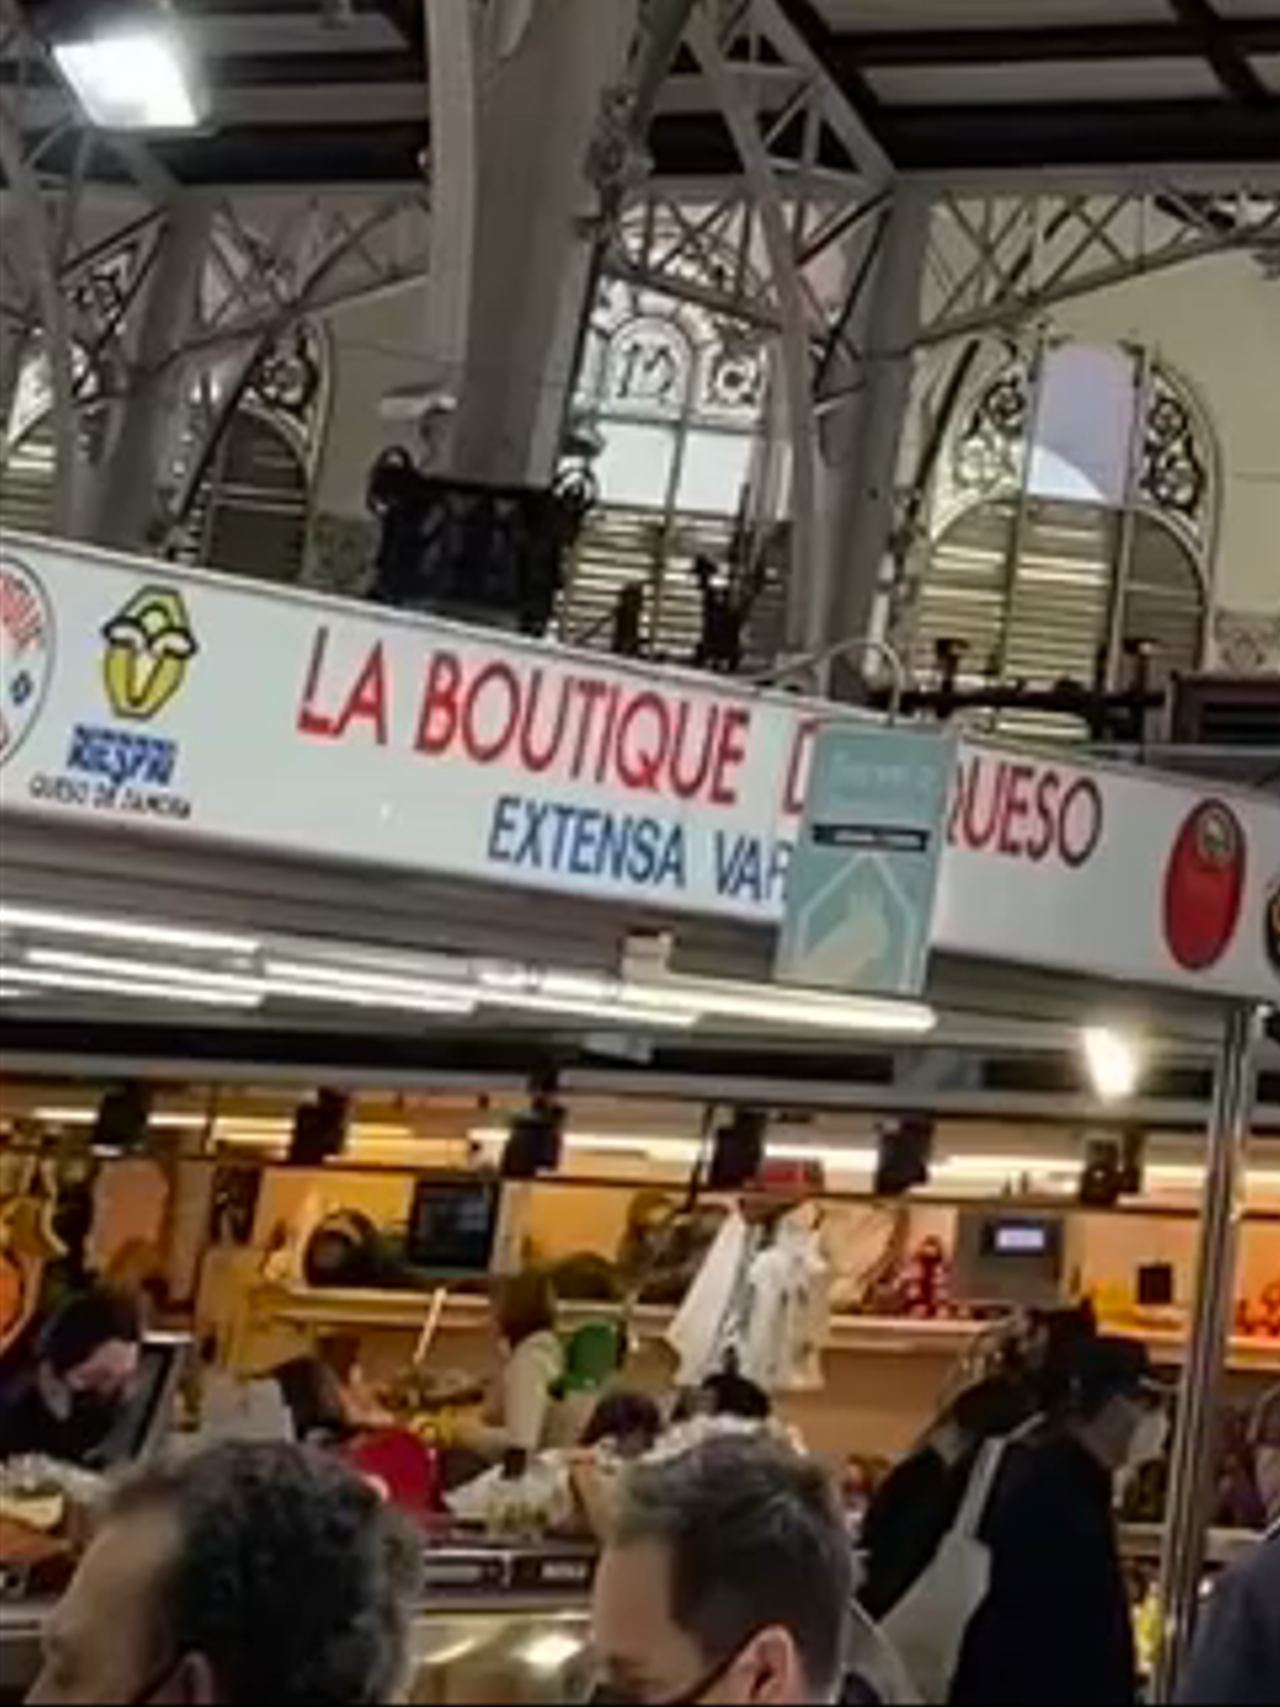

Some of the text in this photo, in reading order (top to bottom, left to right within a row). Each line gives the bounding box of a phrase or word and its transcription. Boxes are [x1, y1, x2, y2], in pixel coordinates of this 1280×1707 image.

[297, 626, 388, 746] LA
[414, 650, 751, 806] BOUTIQUE
[946, 755, 1102, 868] UESO
[488, 796, 686, 887] EXTENSA
